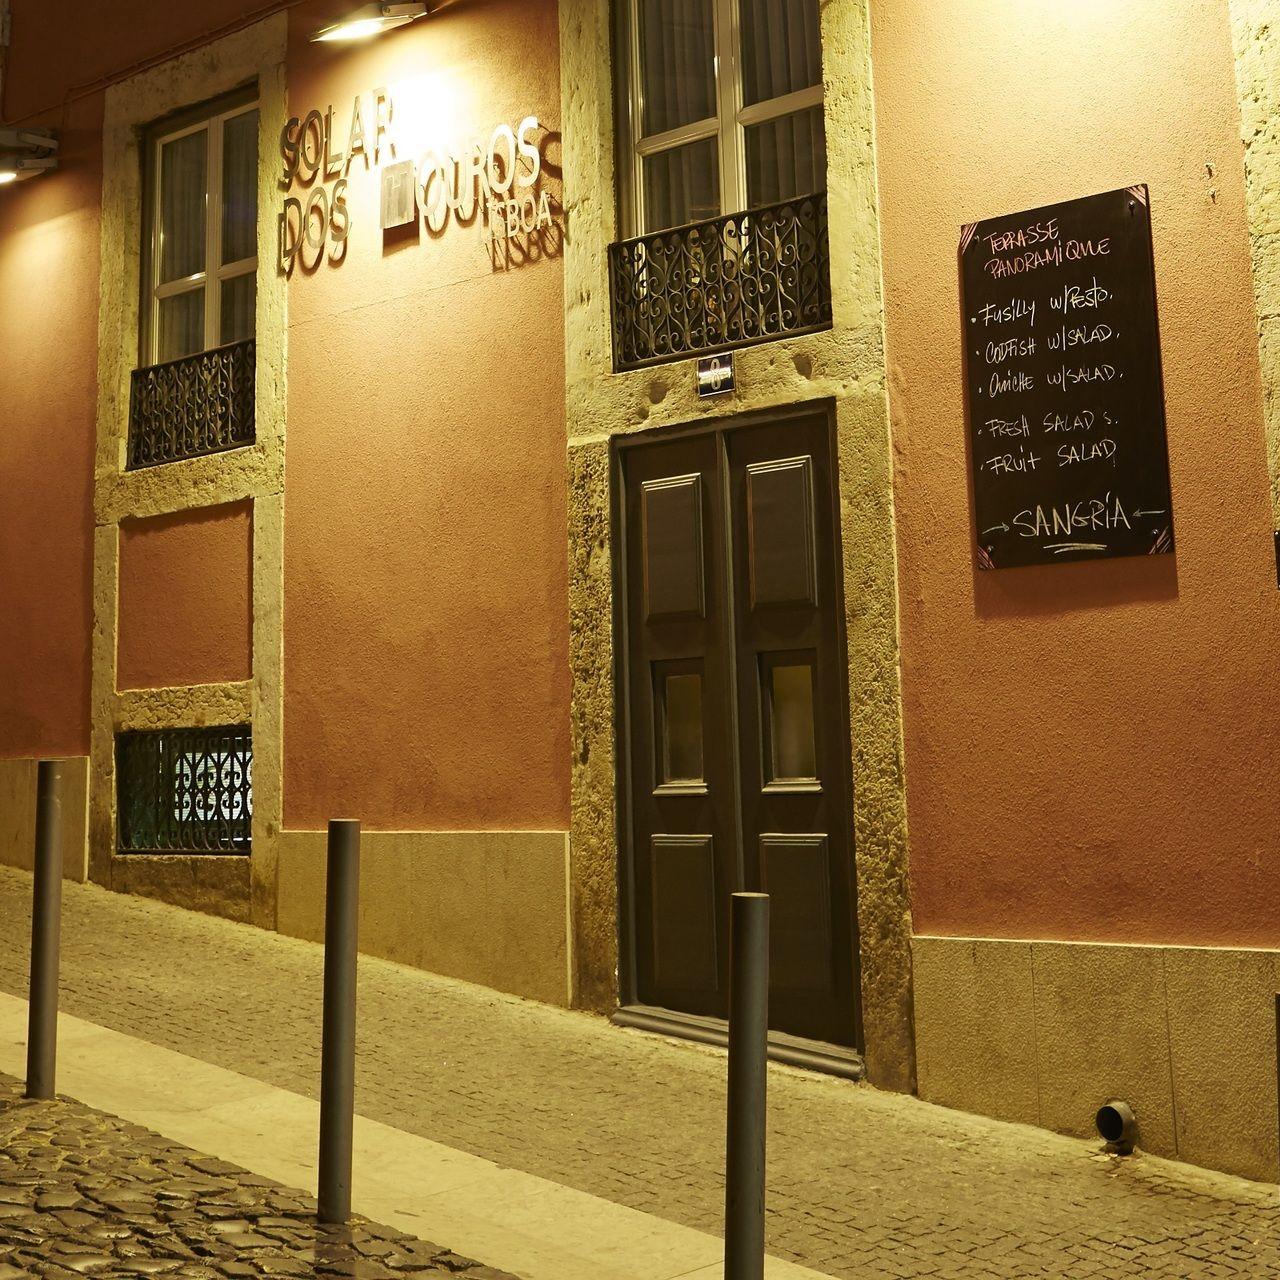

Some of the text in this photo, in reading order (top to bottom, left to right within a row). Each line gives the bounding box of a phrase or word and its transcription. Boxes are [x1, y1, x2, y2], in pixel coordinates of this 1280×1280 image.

[281, 86, 394, 180] SOLAR
[284, 178, 350, 259] DOS
[710, 358, 722, 391] 8
[985, 414, 1030, 438] FRESH
